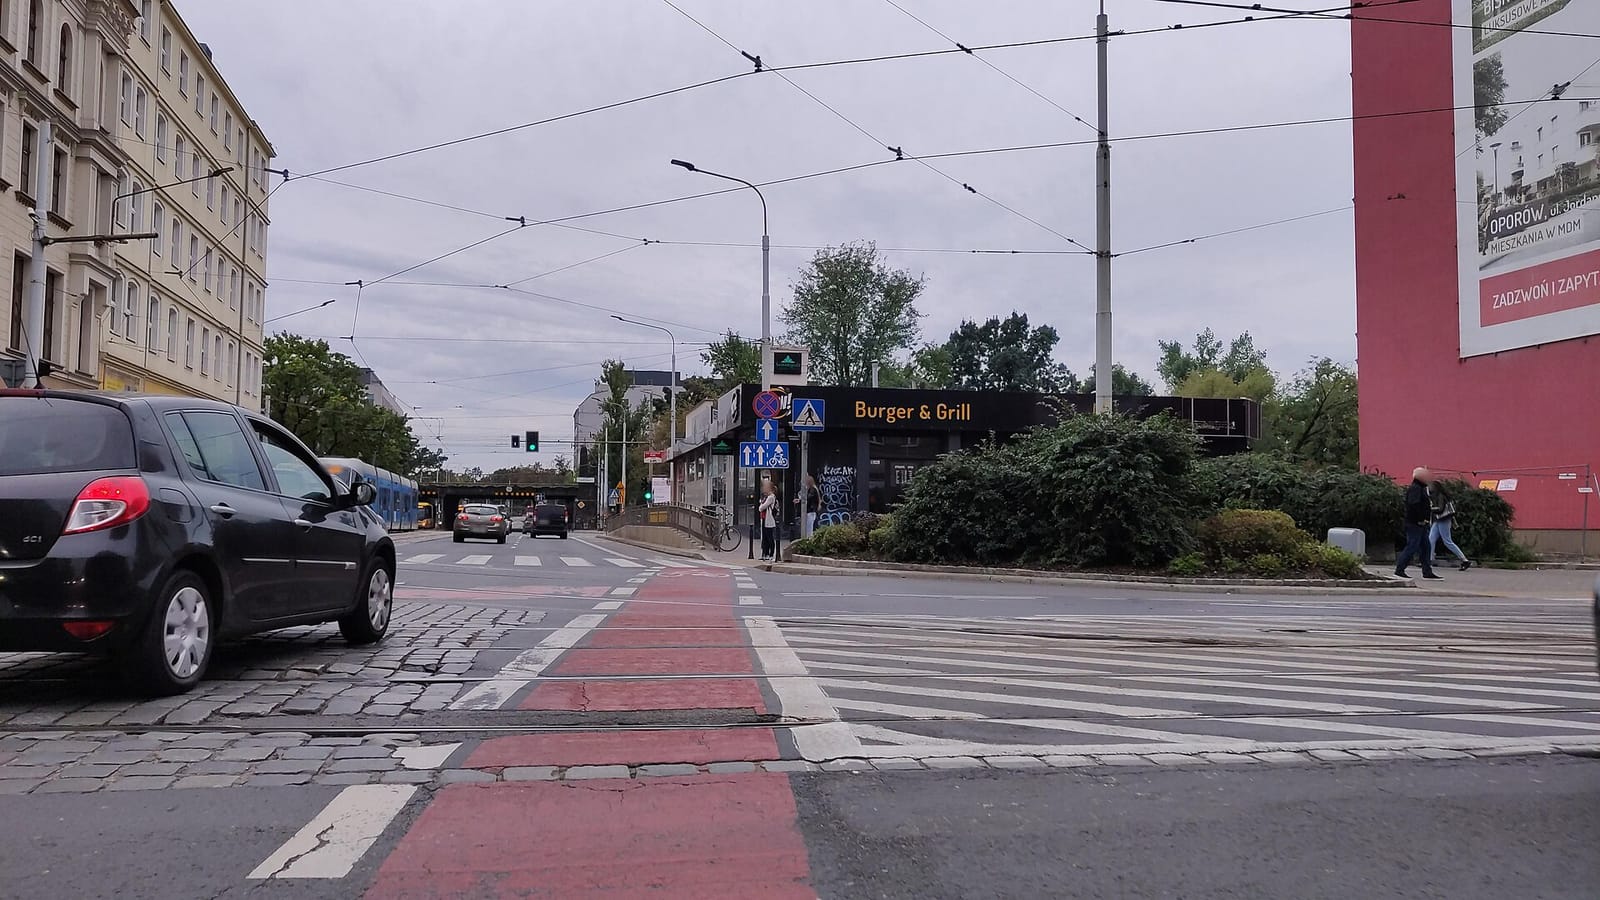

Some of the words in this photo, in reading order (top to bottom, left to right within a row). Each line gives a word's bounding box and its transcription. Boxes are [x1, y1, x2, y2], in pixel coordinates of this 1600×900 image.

[1483, 0, 1538, 35] LUKSUSOWE
[1490, 203, 1547, 235] OPORÓW,
[1550, 203, 1562, 216] ul.
[1491, 230, 1544, 255] MIESZKANIA
[1546, 226, 1556, 239] W
[1558, 218, 1581, 235] MDM
[1492, 279, 1548, 309] ZADZWOŃ
[855, 400, 915, 424] Burger
[919, 404, 931, 420] &
[936, 402, 971, 421] Grill
